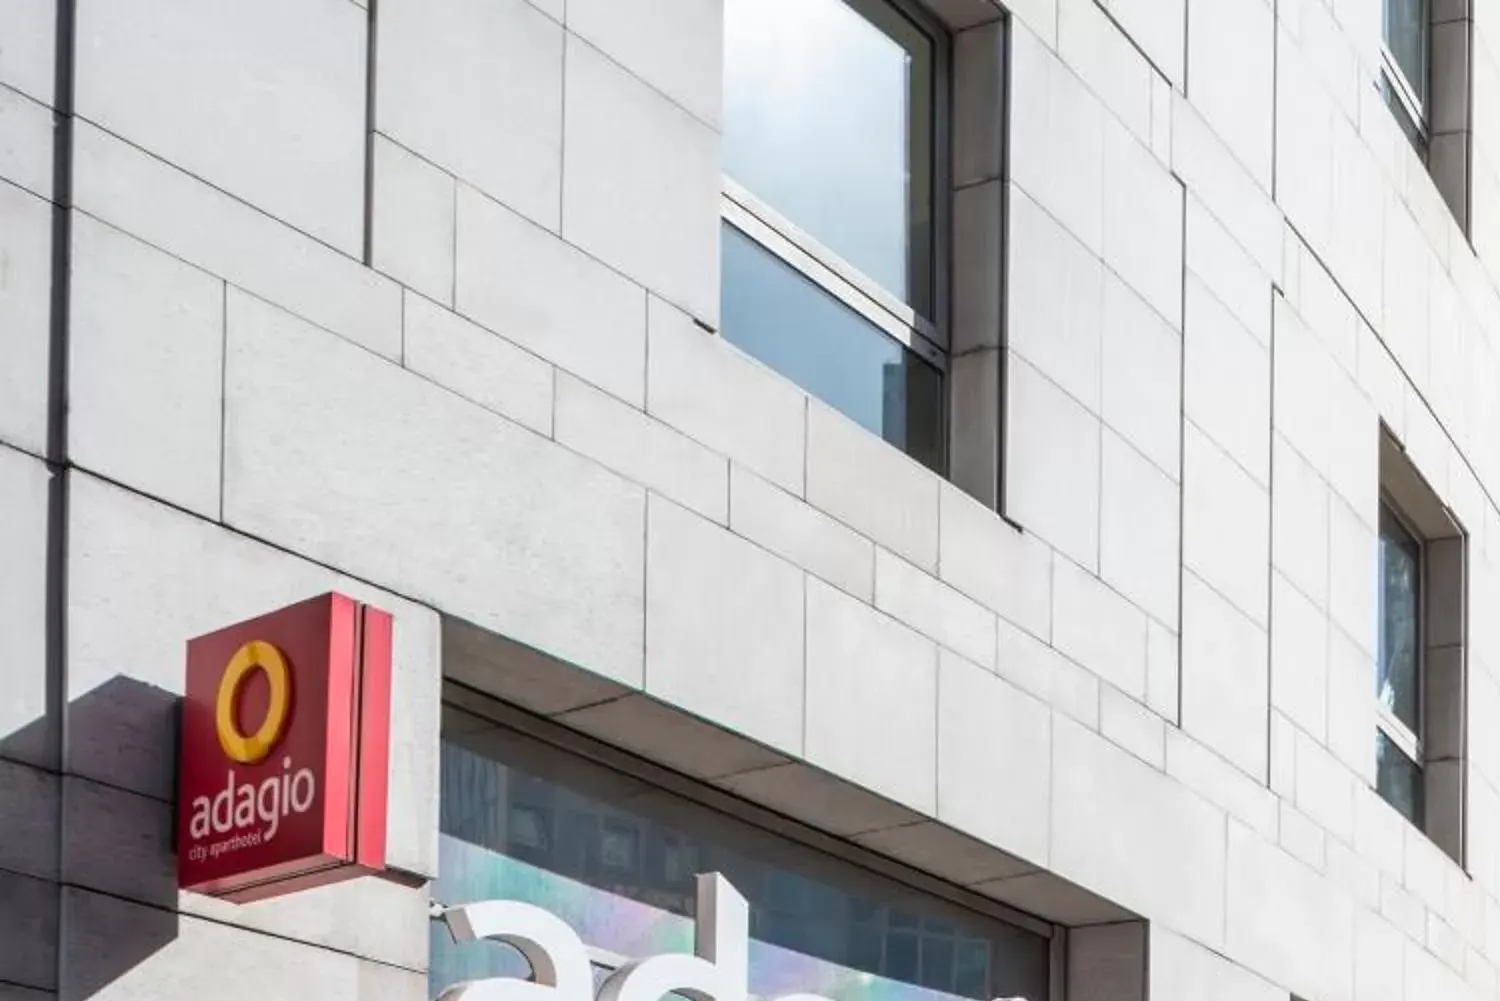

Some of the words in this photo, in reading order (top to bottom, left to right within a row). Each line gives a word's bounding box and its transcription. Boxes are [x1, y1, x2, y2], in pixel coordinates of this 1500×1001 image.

[189, 755, 315, 842] adagio
[188, 844, 209, 863] city
[210, 829, 261, 857] aparthotel
